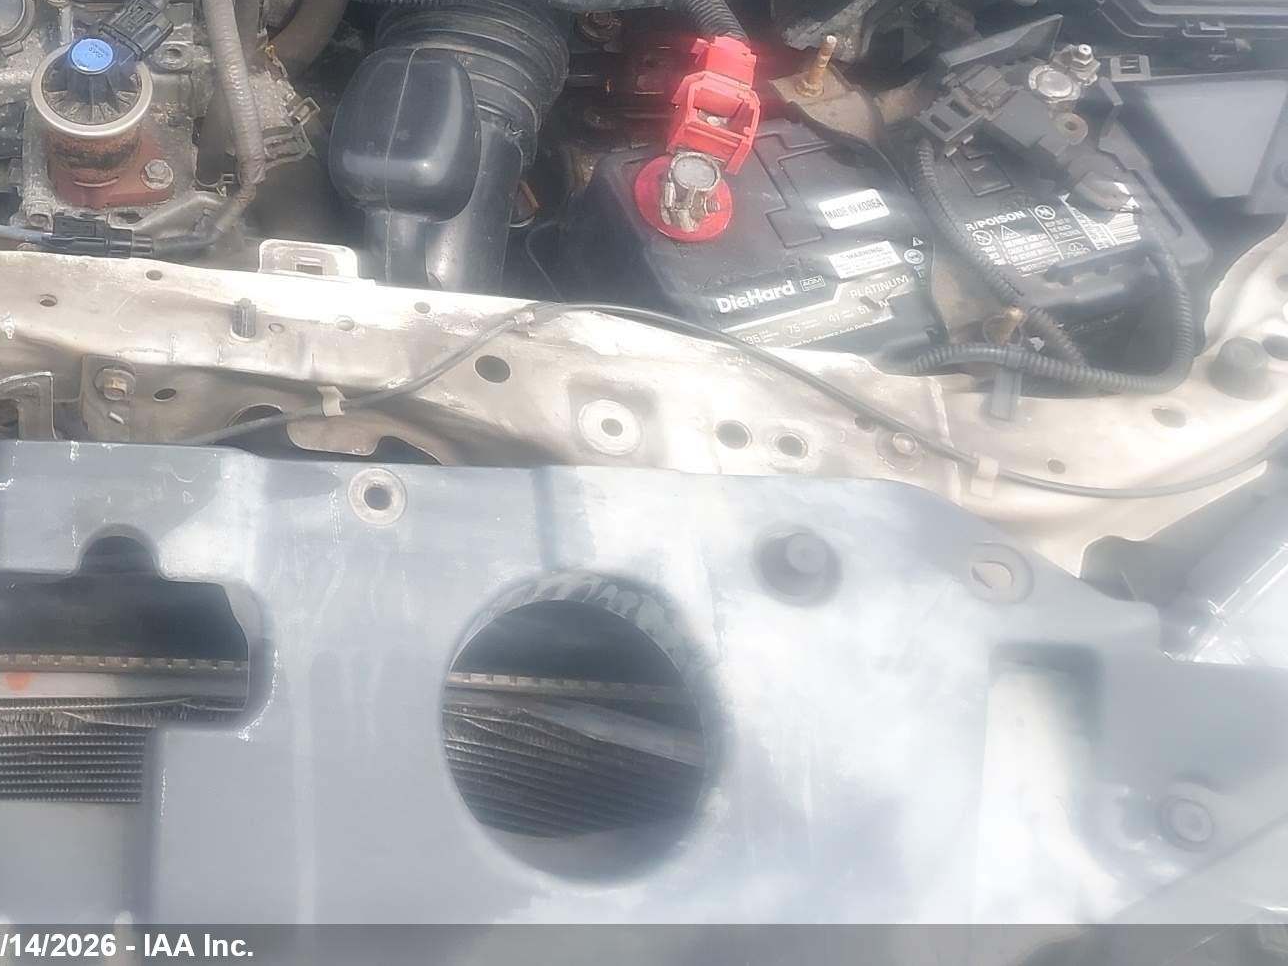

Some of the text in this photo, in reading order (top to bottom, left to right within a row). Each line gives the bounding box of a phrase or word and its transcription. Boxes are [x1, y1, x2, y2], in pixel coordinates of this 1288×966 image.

[824, 197, 884, 220] MADE IN KOREA
[715, 280, 796, 314] DieHard
[849, 274, 910, 299] PLATINUM
